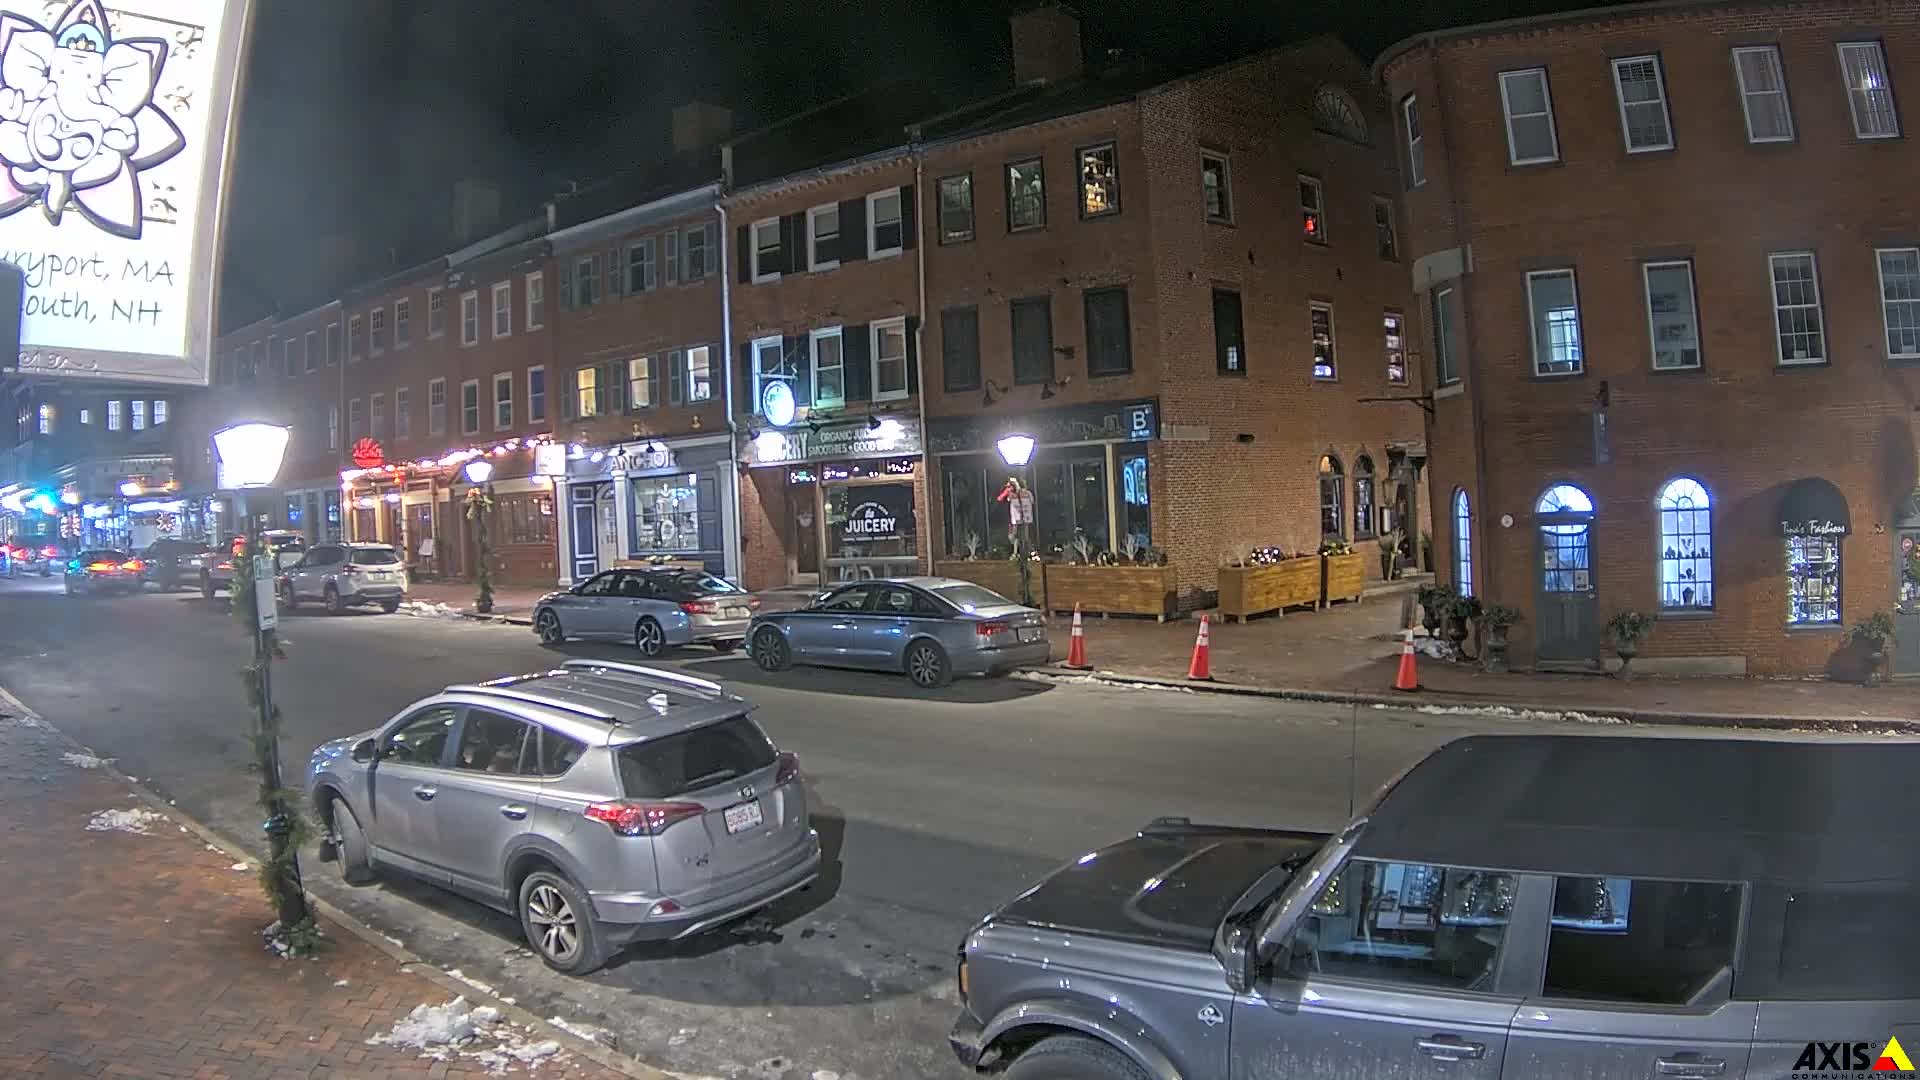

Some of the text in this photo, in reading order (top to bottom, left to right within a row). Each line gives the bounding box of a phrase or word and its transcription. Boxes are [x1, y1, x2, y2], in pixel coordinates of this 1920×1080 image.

[121, 257, 175, 287] MA
[24, 290, 162, 326] outh, NH
[820, 430, 853, 443] ORGANIC
[808, 442, 848, 456] SMOOTHIES
[853, 440, 876, 453] GOOD
[845, 517, 896, 533] JUICERY
